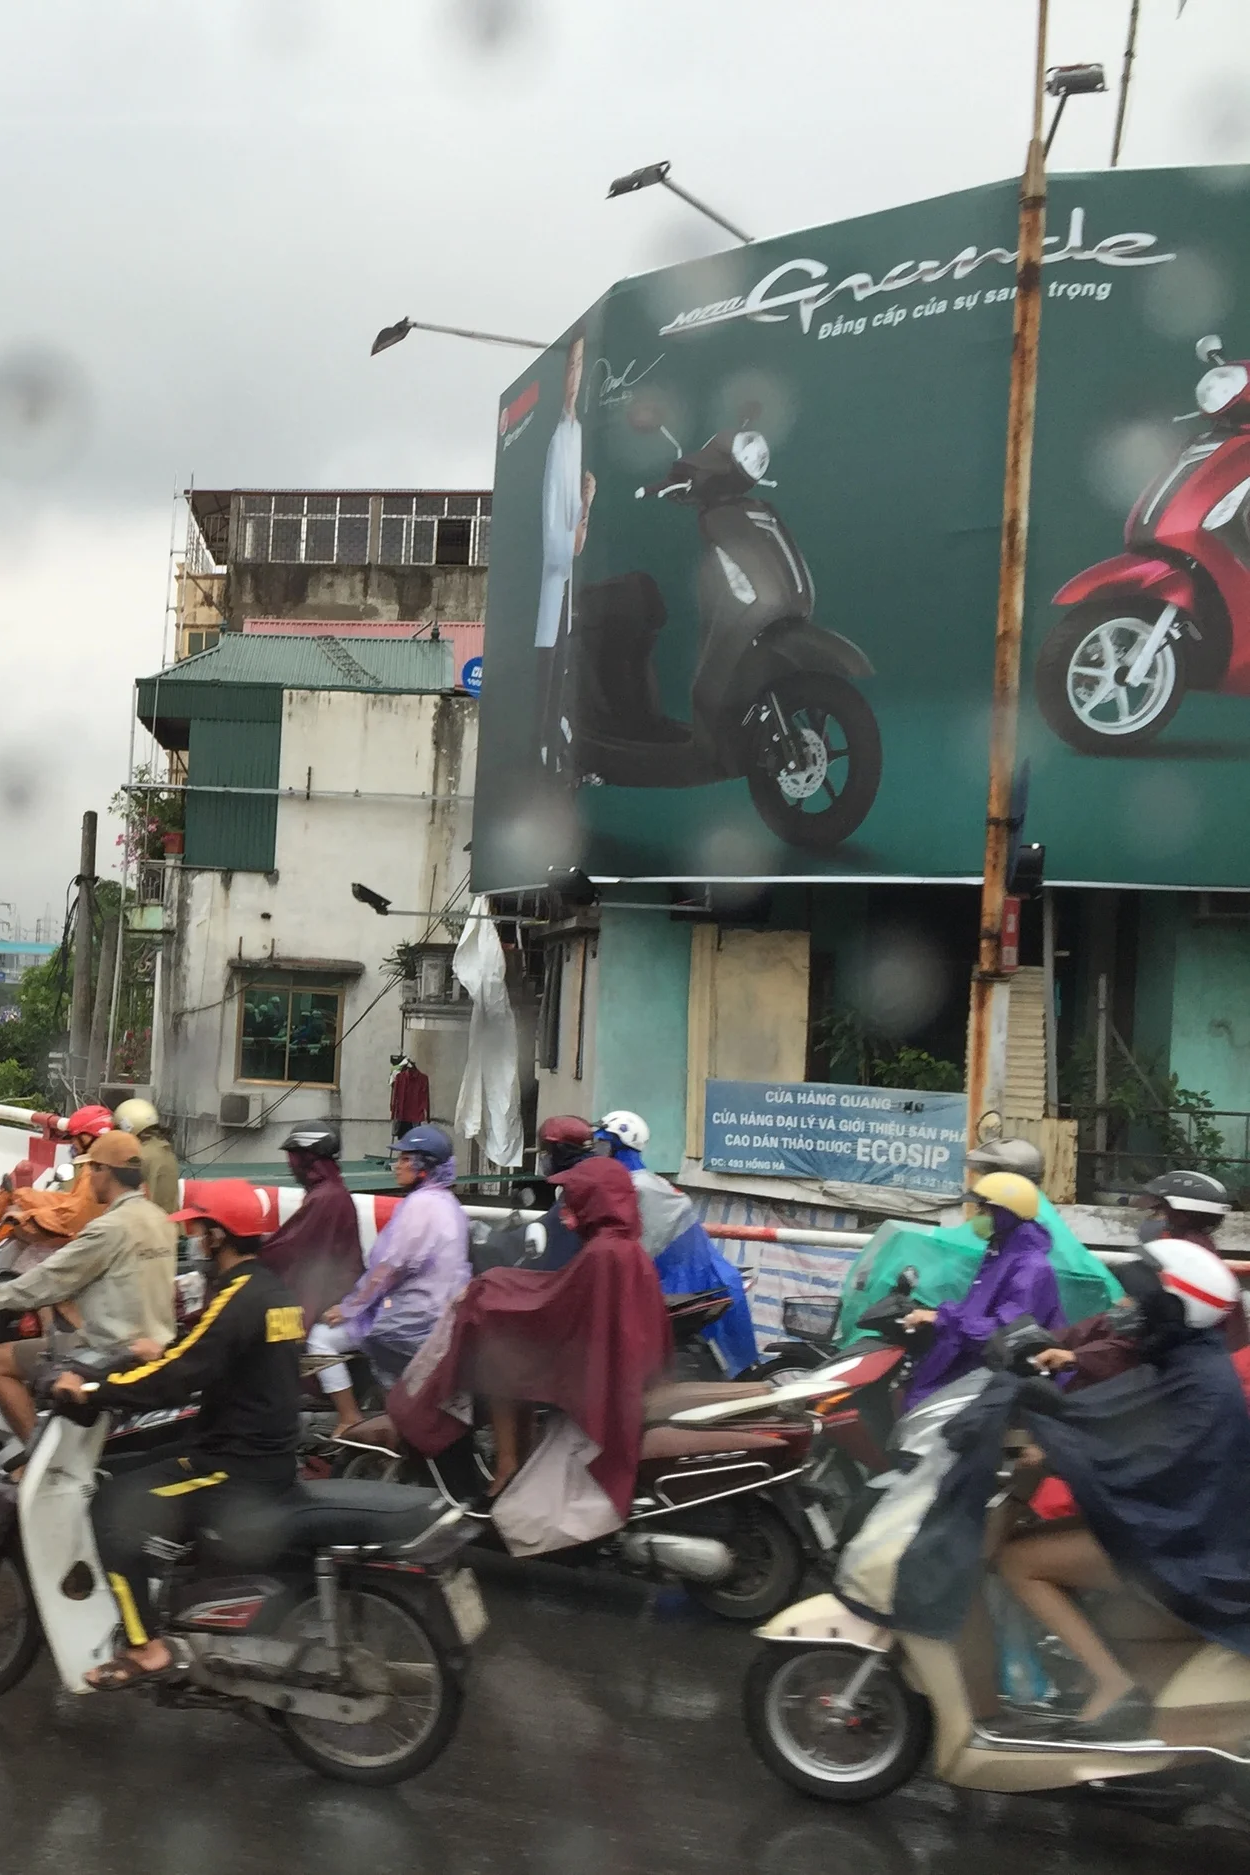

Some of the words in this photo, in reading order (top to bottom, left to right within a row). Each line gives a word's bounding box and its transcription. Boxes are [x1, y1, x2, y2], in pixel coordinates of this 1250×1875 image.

[817, 314, 866, 340] Đẳng
[871, 304, 907, 327] cấp
[912, 296, 949, 318] của
[953, 290, 981, 311] sự
[983, 286, 1018, 304] sa
[1048, 281, 1112, 300] trọng
[765, 1086, 794, 1104] CỬA
[797, 1090, 836, 1107] HÀNG
[839, 1094, 891, 1110] QUANG
[712, 1108, 737, 1125] CỬA
[740, 1110, 773, 1127] HÀNG
[776, 1114, 798, 1131] ĐẠI
[800, 1114, 816, 1129] LÝ
[818, 1115, 836, 1131] VÀ
[839, 1117, 866, 1132] GIỚI
[869, 1120, 906, 1139] THIỆU
[909, 1122, 938, 1140] SẢN
[940, 1127, 967, 1142] PH
[725, 1133, 750, 1147] CAO
[753, 1133, 779, 1148] DÁN
[781, 1133, 814, 1151] THẢO
[816, 1139, 852, 1157] DƯỢC
[856, 1137, 950, 1170] ECOSIP
